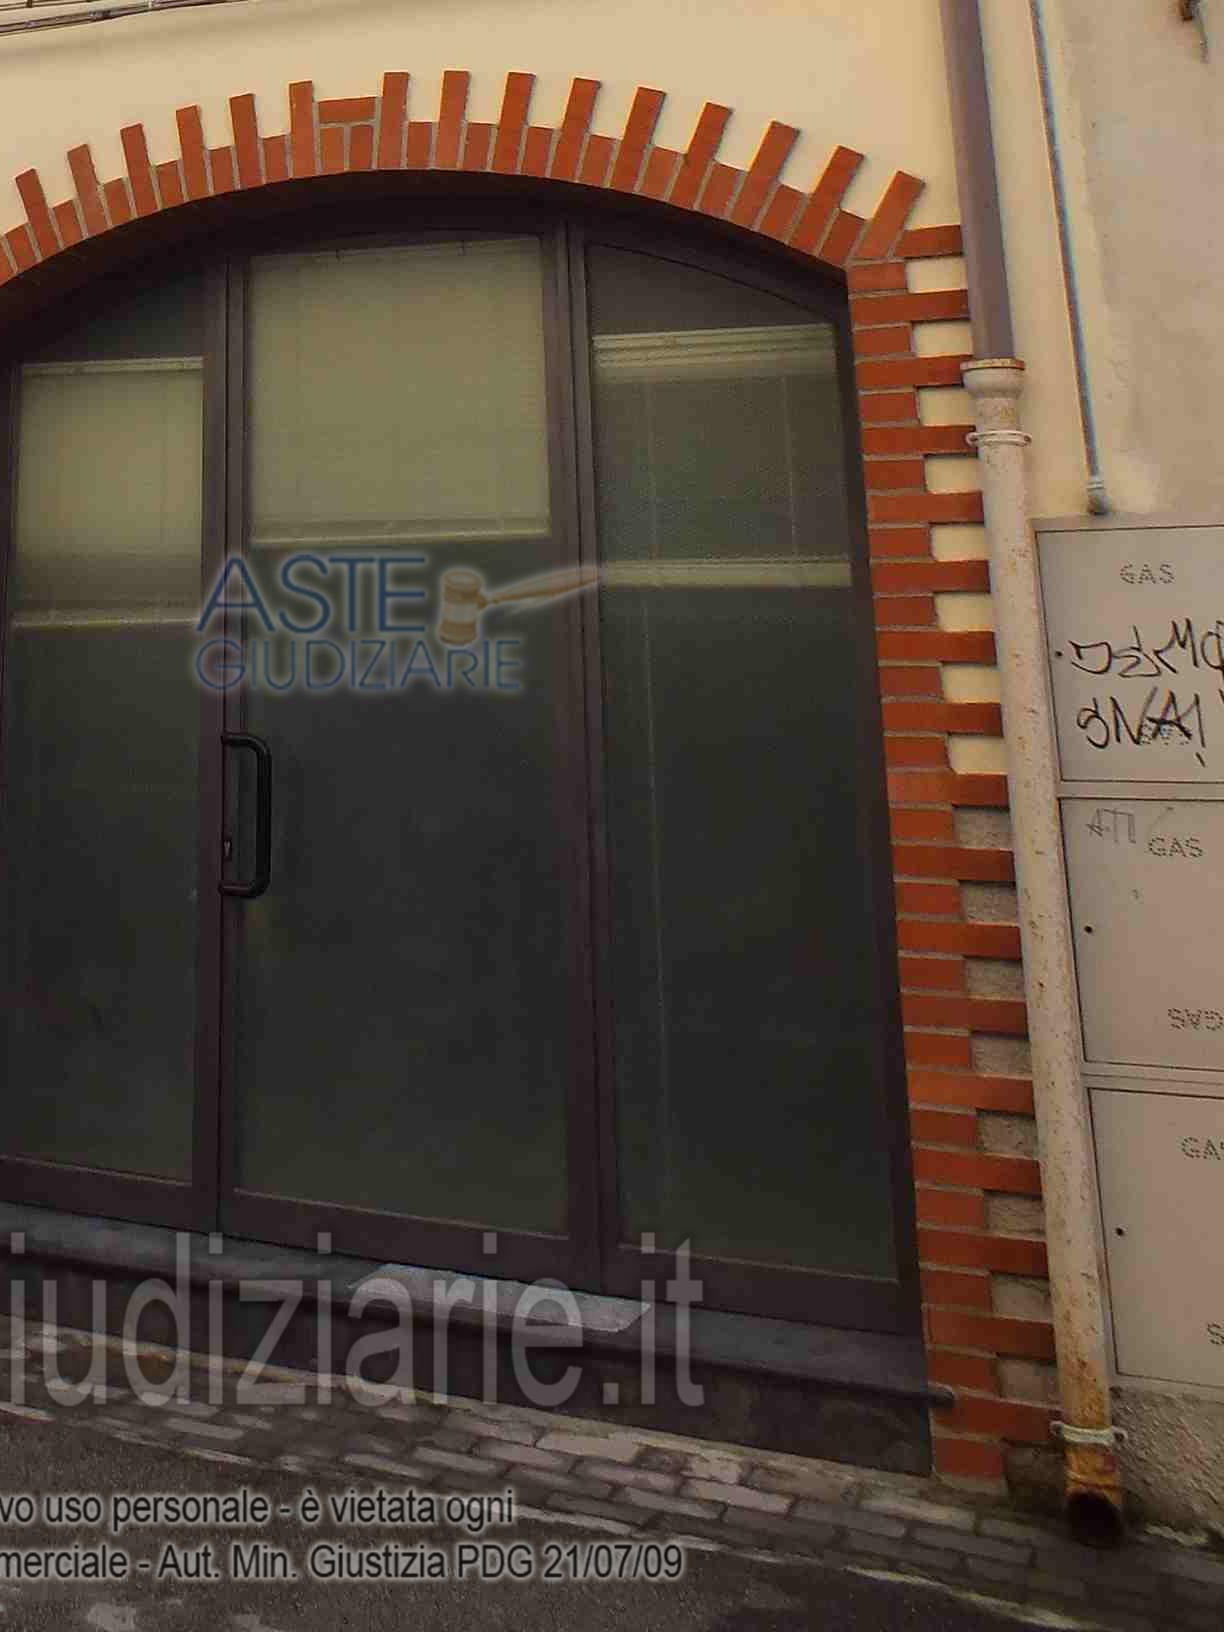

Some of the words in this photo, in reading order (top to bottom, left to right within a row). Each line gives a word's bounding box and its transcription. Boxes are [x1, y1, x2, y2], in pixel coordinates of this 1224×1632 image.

[1119, 562, 1175, 584] GAS
[1147, 835, 1204, 858] GAS
[1180, 1136, 1224, 1160] GA
